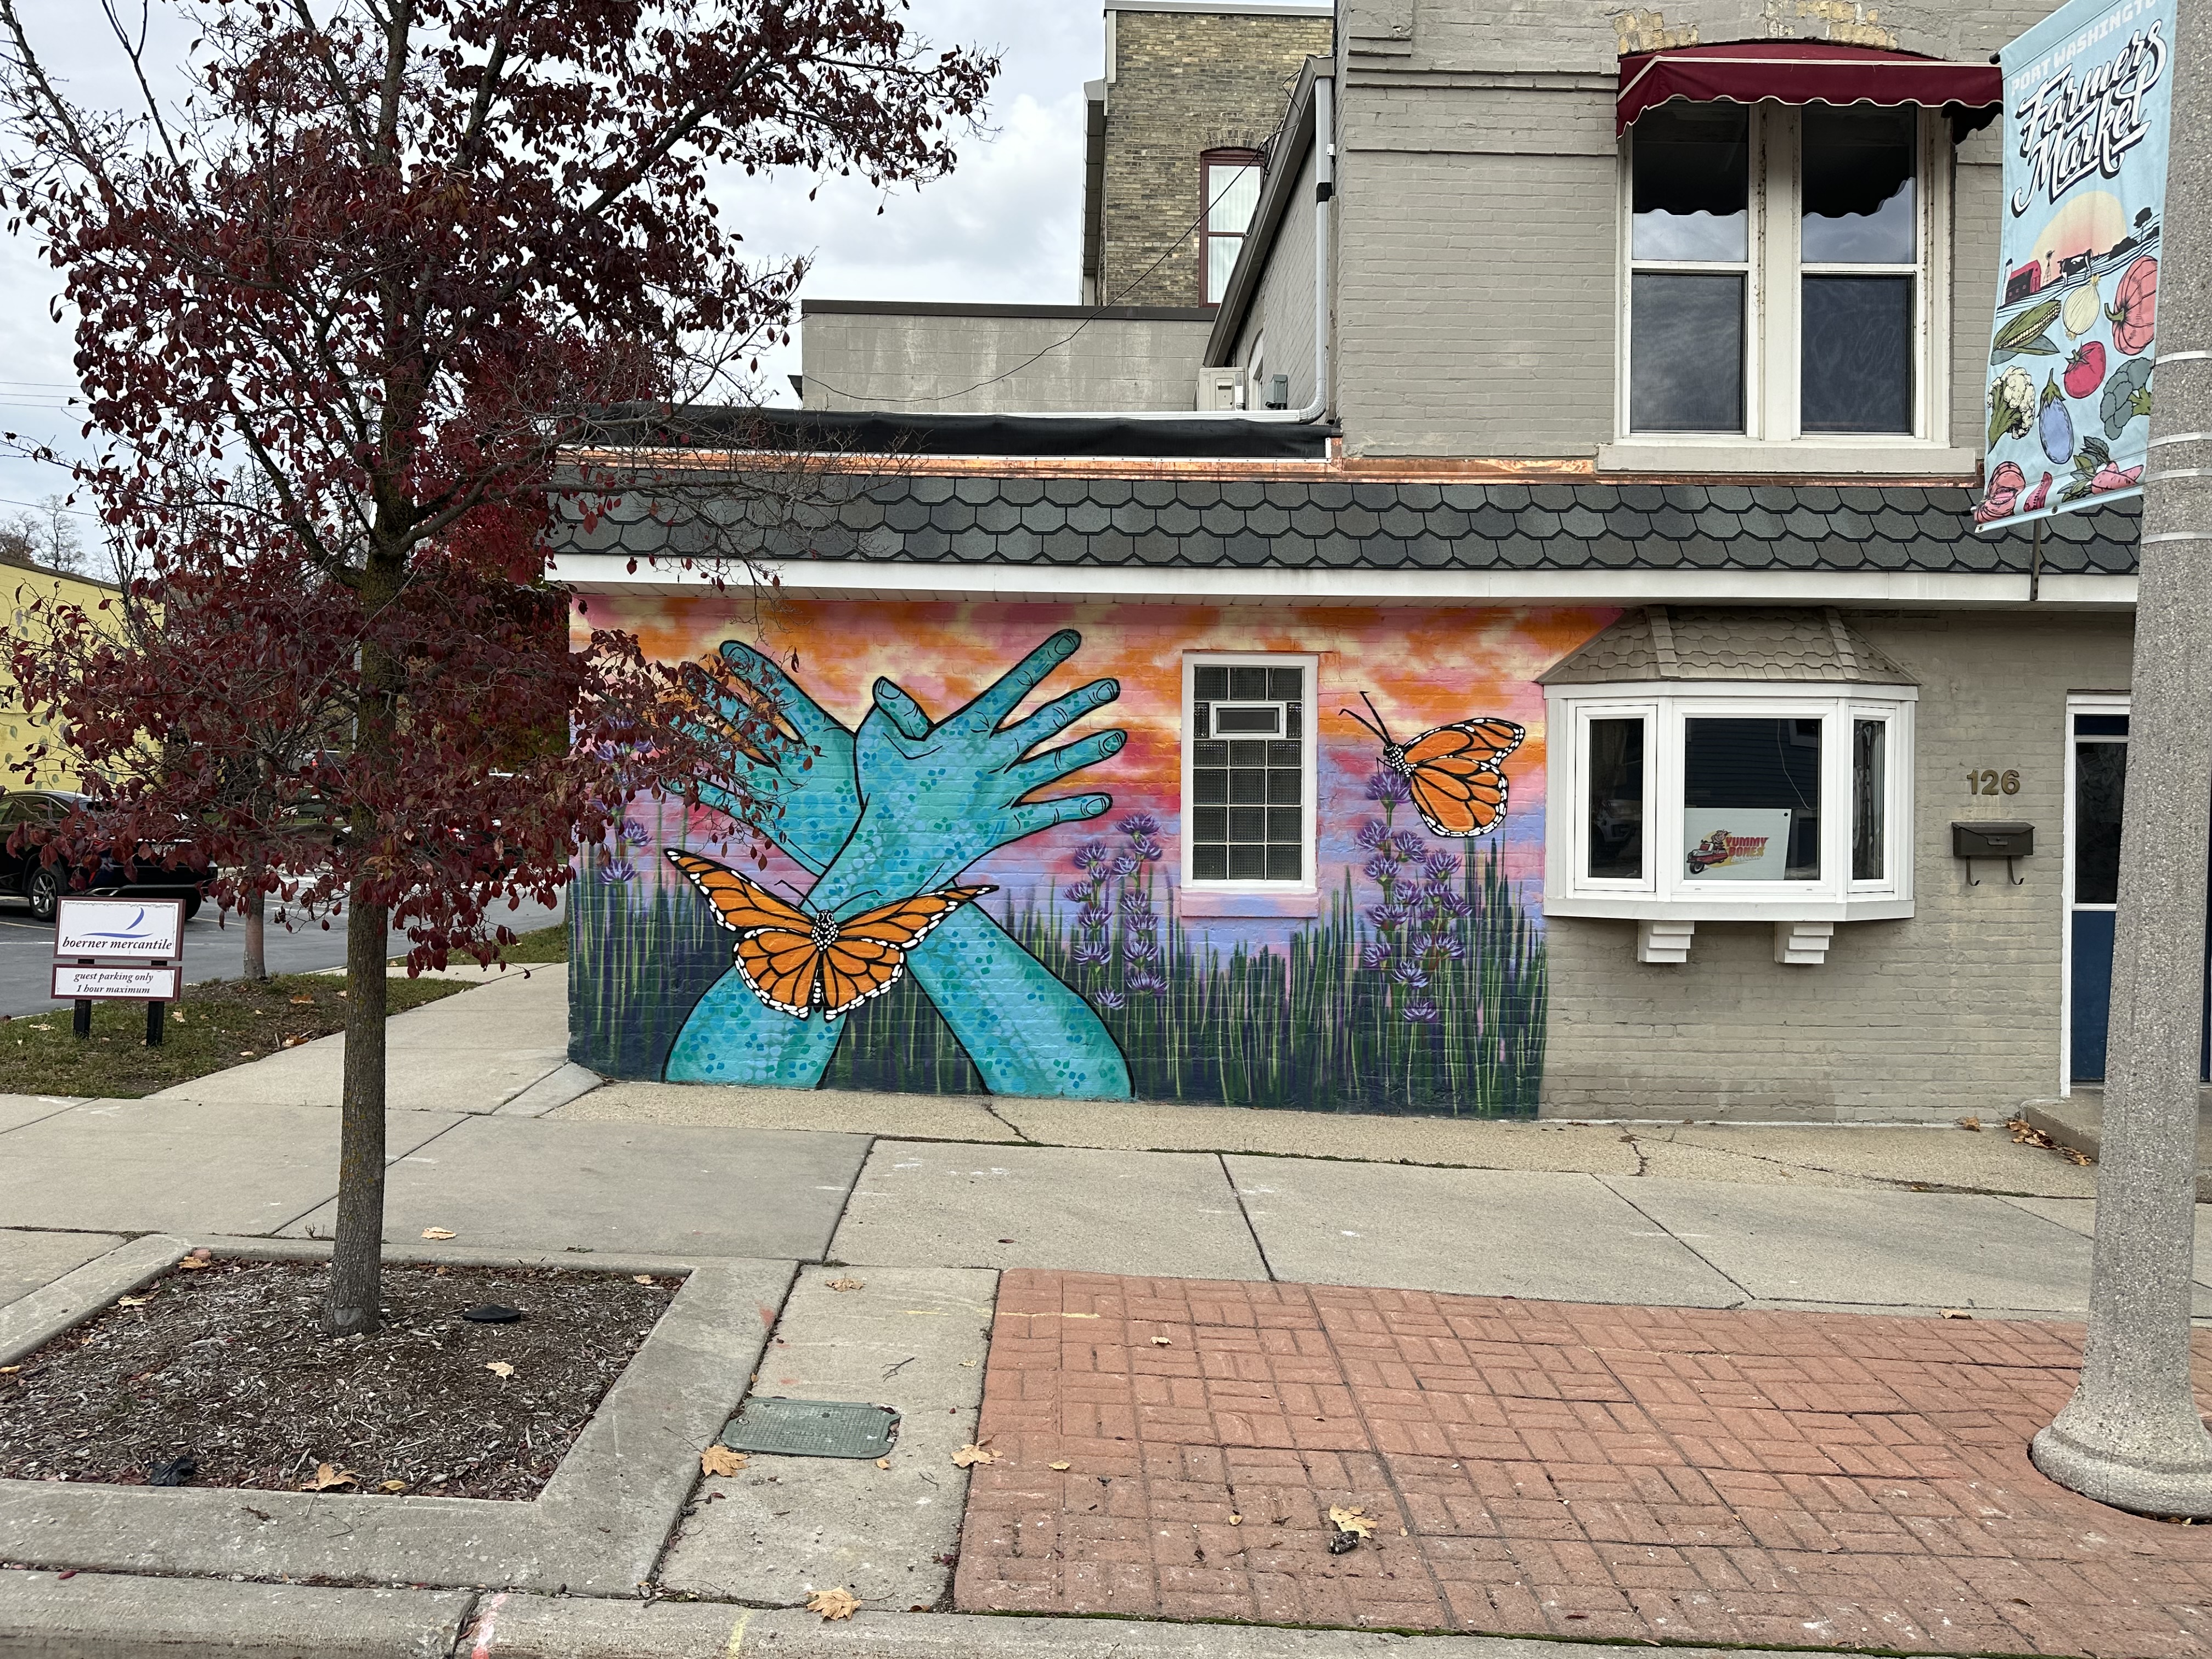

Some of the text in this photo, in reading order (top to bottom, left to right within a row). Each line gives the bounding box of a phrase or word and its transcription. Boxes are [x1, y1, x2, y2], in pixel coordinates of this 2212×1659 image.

[2011, 57, 2051, 97] PORT
[2016, 19, 2167, 157] Farmers
[2011, 62, 2152, 218] Market
[1966, 769, 2020, 795] 126
[1725, 837, 1770, 847] YUMMY
[1728, 847, 1765, 857] BONES
[62, 936, 173, 950] boerner mercantile
[74, 972, 154, 983] guest parking only
[83, 984, 105, 993] hour
[105, 985, 150, 994] maximum
